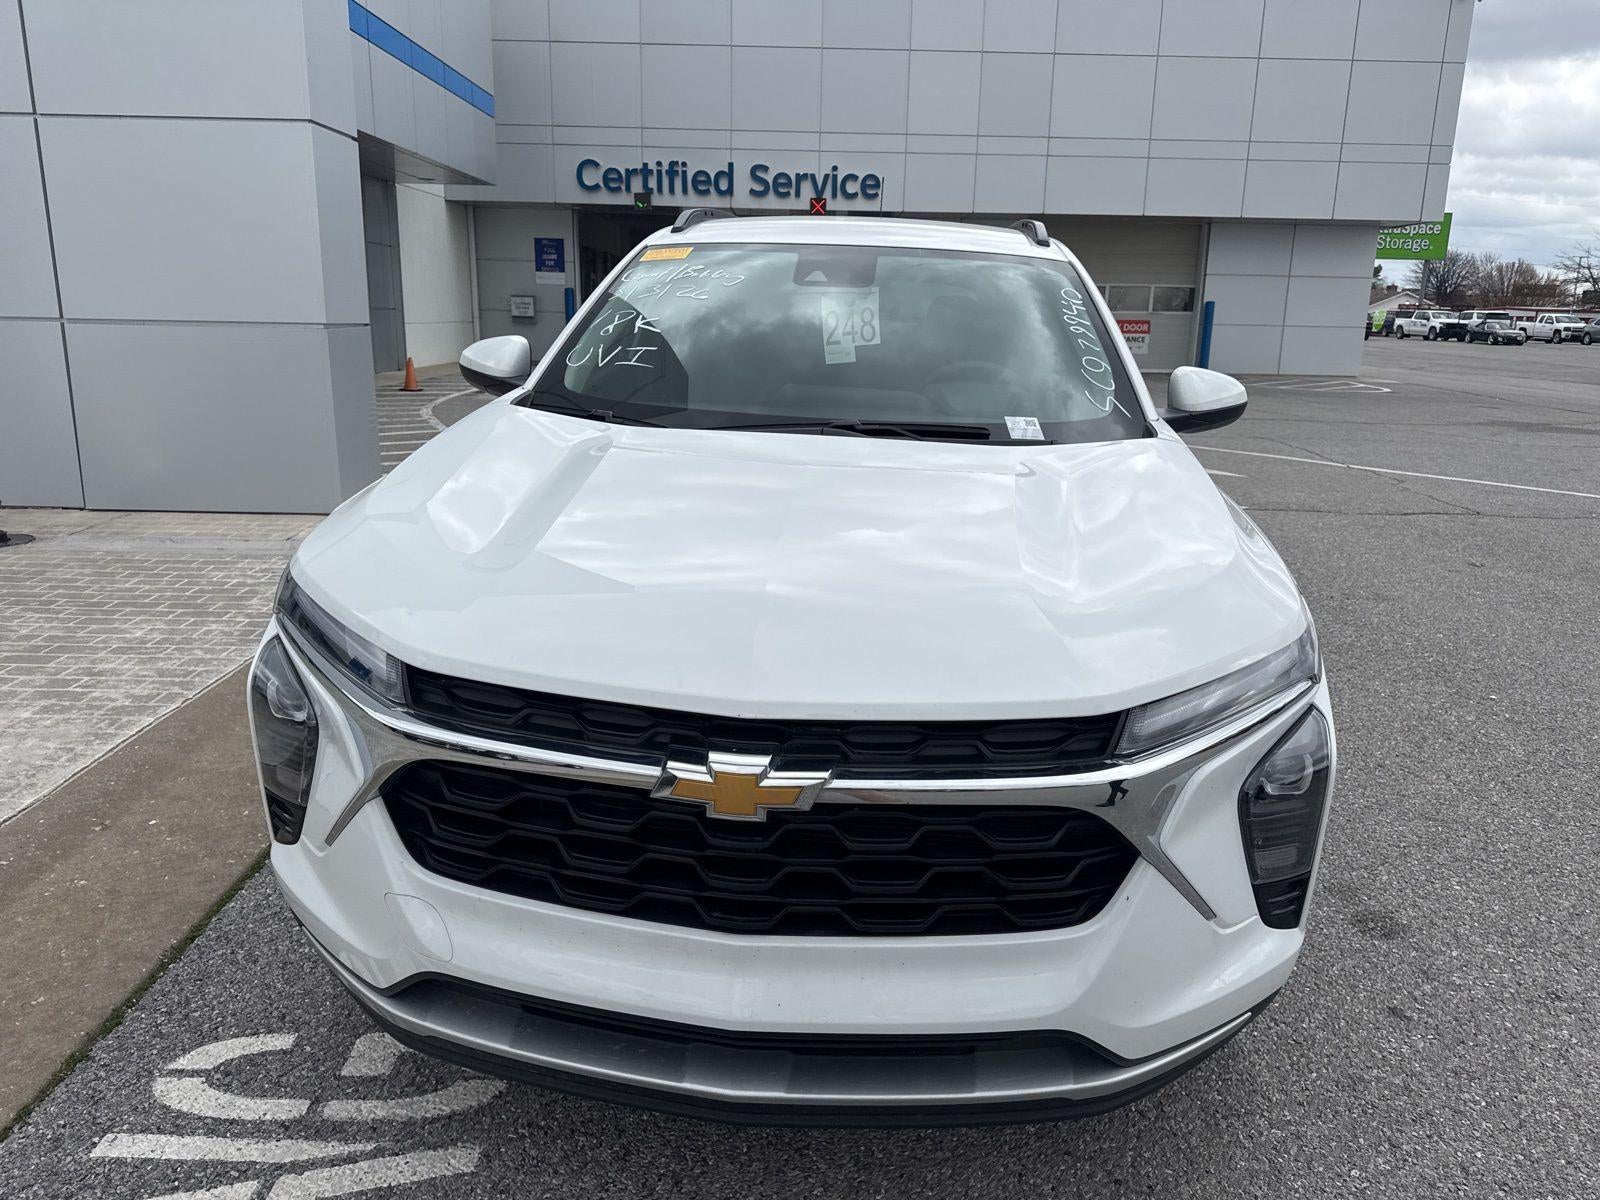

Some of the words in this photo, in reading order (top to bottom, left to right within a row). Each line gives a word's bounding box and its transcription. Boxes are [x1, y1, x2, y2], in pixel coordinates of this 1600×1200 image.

[576, 158, 735, 197] Certified
[749, 163, 882, 200] Service
[1377, 234, 1430, 252] Storage
[825, 306, 876, 346] 248
[1123, 323, 1149, 332] DOOR
